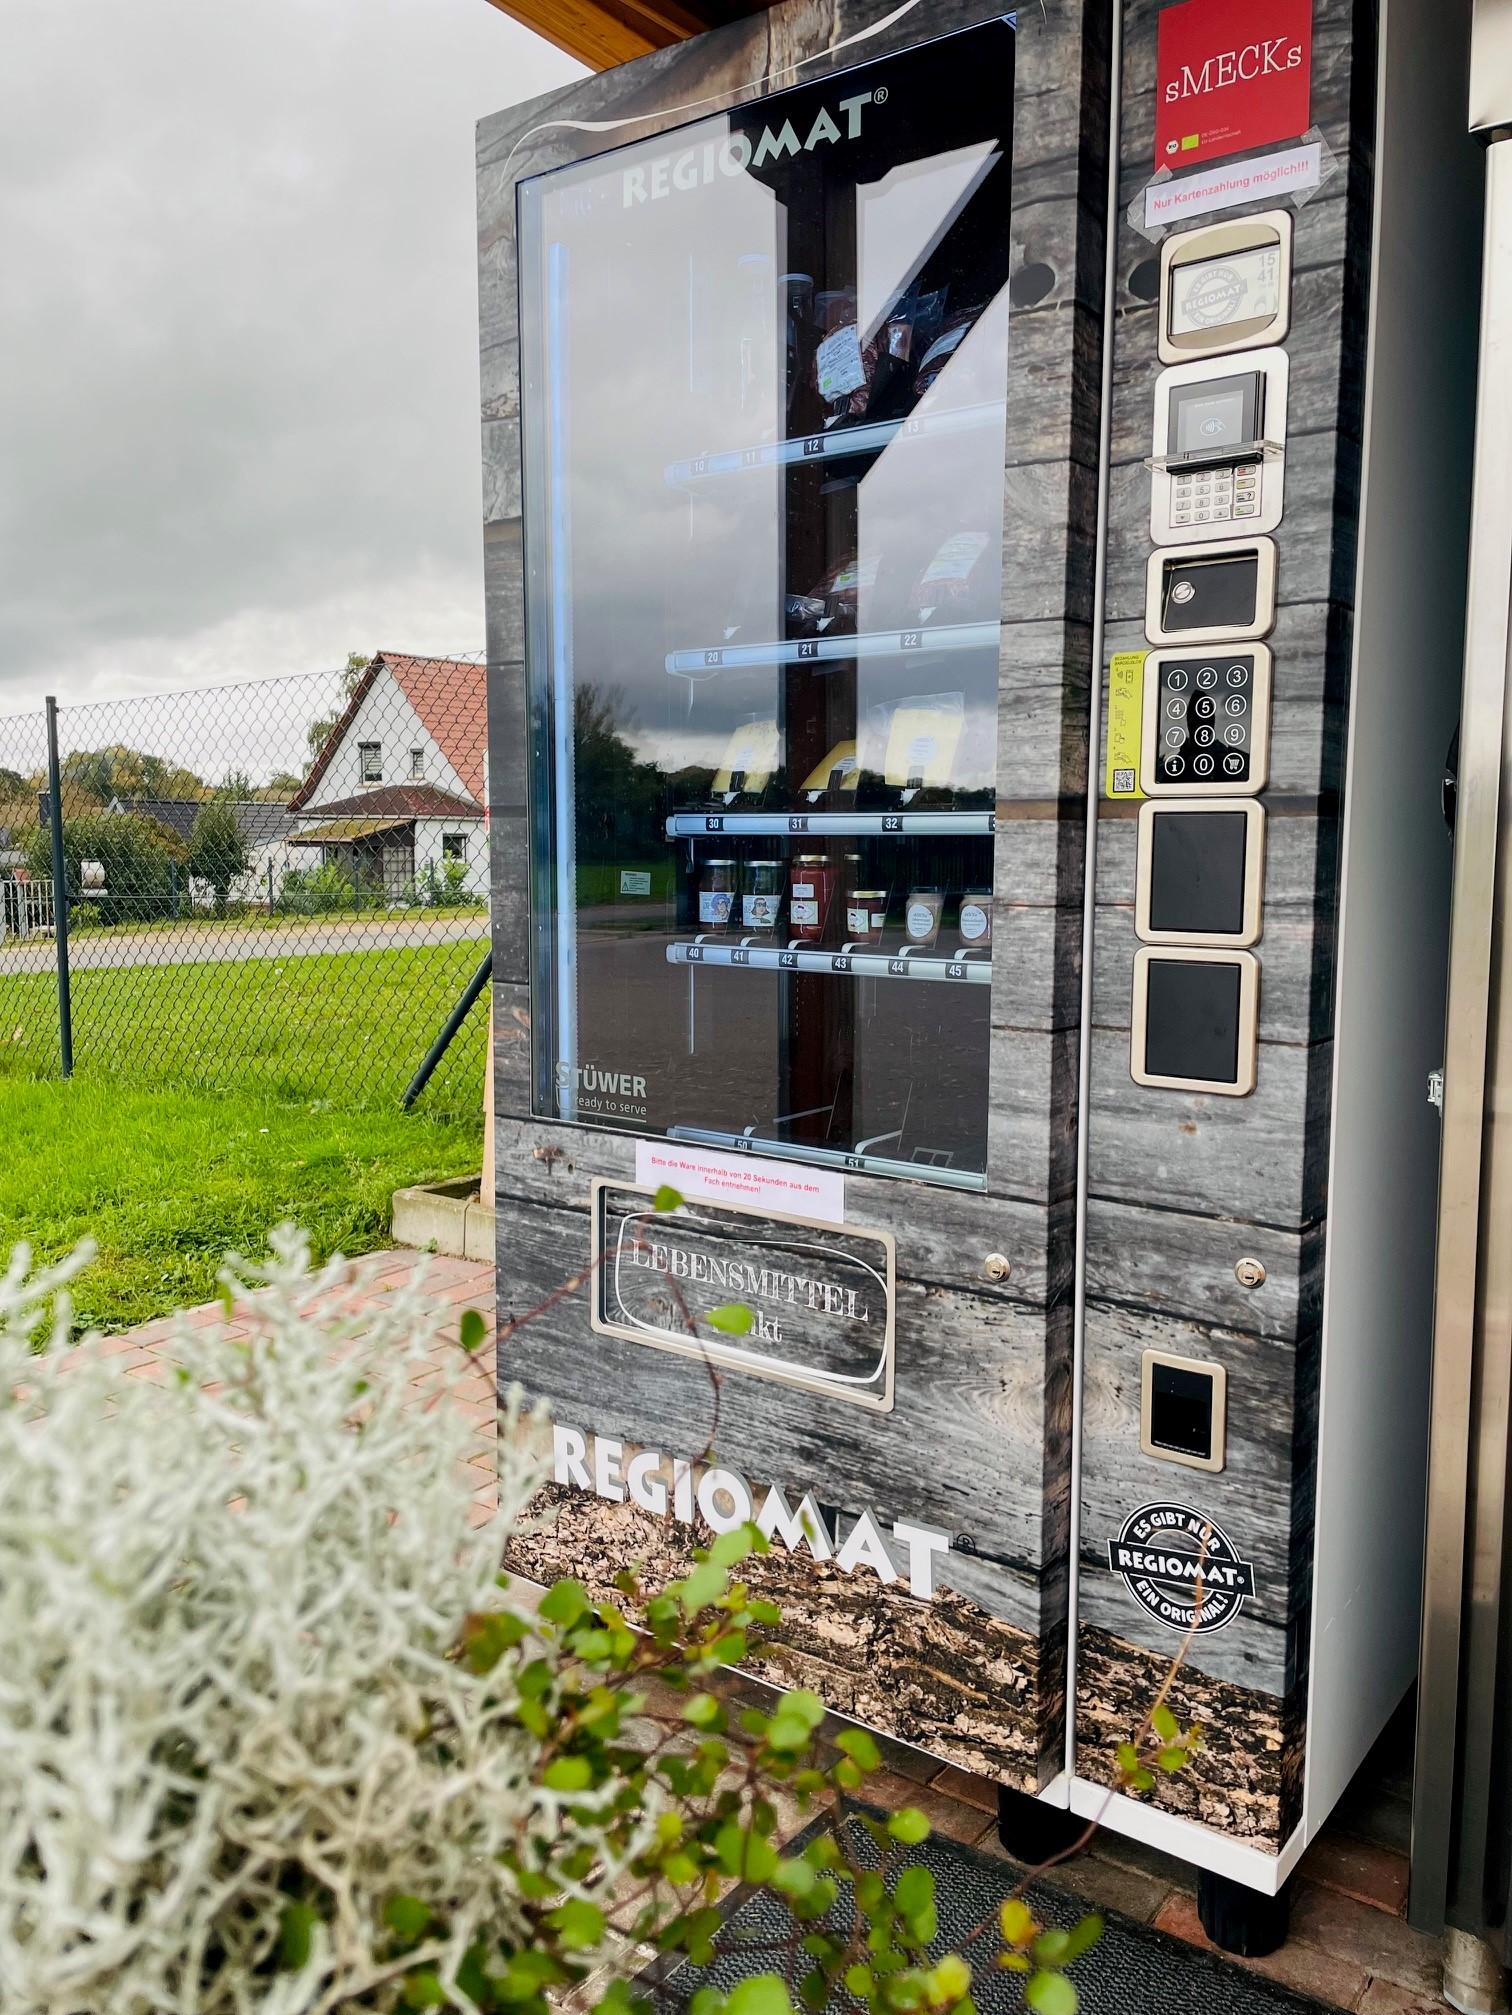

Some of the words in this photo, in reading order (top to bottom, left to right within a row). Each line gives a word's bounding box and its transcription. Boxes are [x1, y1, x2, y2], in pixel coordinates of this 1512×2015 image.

[1165, 37, 1302, 103] sMECKs
[1153, 199, 1172, 209] Nur
[1174, 177, 1250, 203] Kartenzahlung
[1253, 160, 1309, 182] möglich!!!
[1259, 253, 1276, 267] 15
[1257, 267, 1274, 282] 41
[807, 438, 819, 452] 12
[904, 634, 917, 646] 22
[801, 643, 813, 655] 21
[707, 652, 718, 663] 20
[1175, 675, 1180, 686] 1
[1203, 672, 1211, 685] 2
[1233, 670, 1241, 683] 3
[1172, 704, 1180, 715] 4
[1201, 701, 1210, 714] 5
[1231, 700, 1240, 711] 6
[1172, 731, 1180, 743] 7
[1200, 729, 1208, 742] 8
[1231, 729, 1239, 741] 9
[1199, 758, 1207, 771] 0
[708, 818, 719, 829] 30
[792, 818, 802, 829] 31
[885, 817, 898, 829] 32
[688, 948, 699, 959] 40
[733, 950, 744, 961] 41
[781, 954, 793, 965] 42
[834, 957, 847, 969] 43
[891, 960, 904, 973] 44
[949, 964, 961, 977] 45
[606, 1100, 617, 1110] to
[620, 1102, 647, 1116] serve
[737, 1140, 748, 1150] 50
[848, 1158, 859, 1167] 51
[651, 1157, 666, 1166] Bitte
[679, 1162, 696, 1171] Ware
[697, 1164, 728, 1177] innerhalb
[753, 1175, 787, 1187] Sekunden
[803, 1184, 820, 1193] dem
[704, 1176, 719, 1185] Fach
[721, 1180, 760, 1193] entnehmen!
[630, 1238, 868, 1322] LEBENSMITTEL
[1133, 1519, 1151, 1539] ES
[1150, 1511, 1186, 1527] GIBT
[1187, 1518, 1221, 1552] NUR
[1136, 1579, 1160, 1607] EIN
